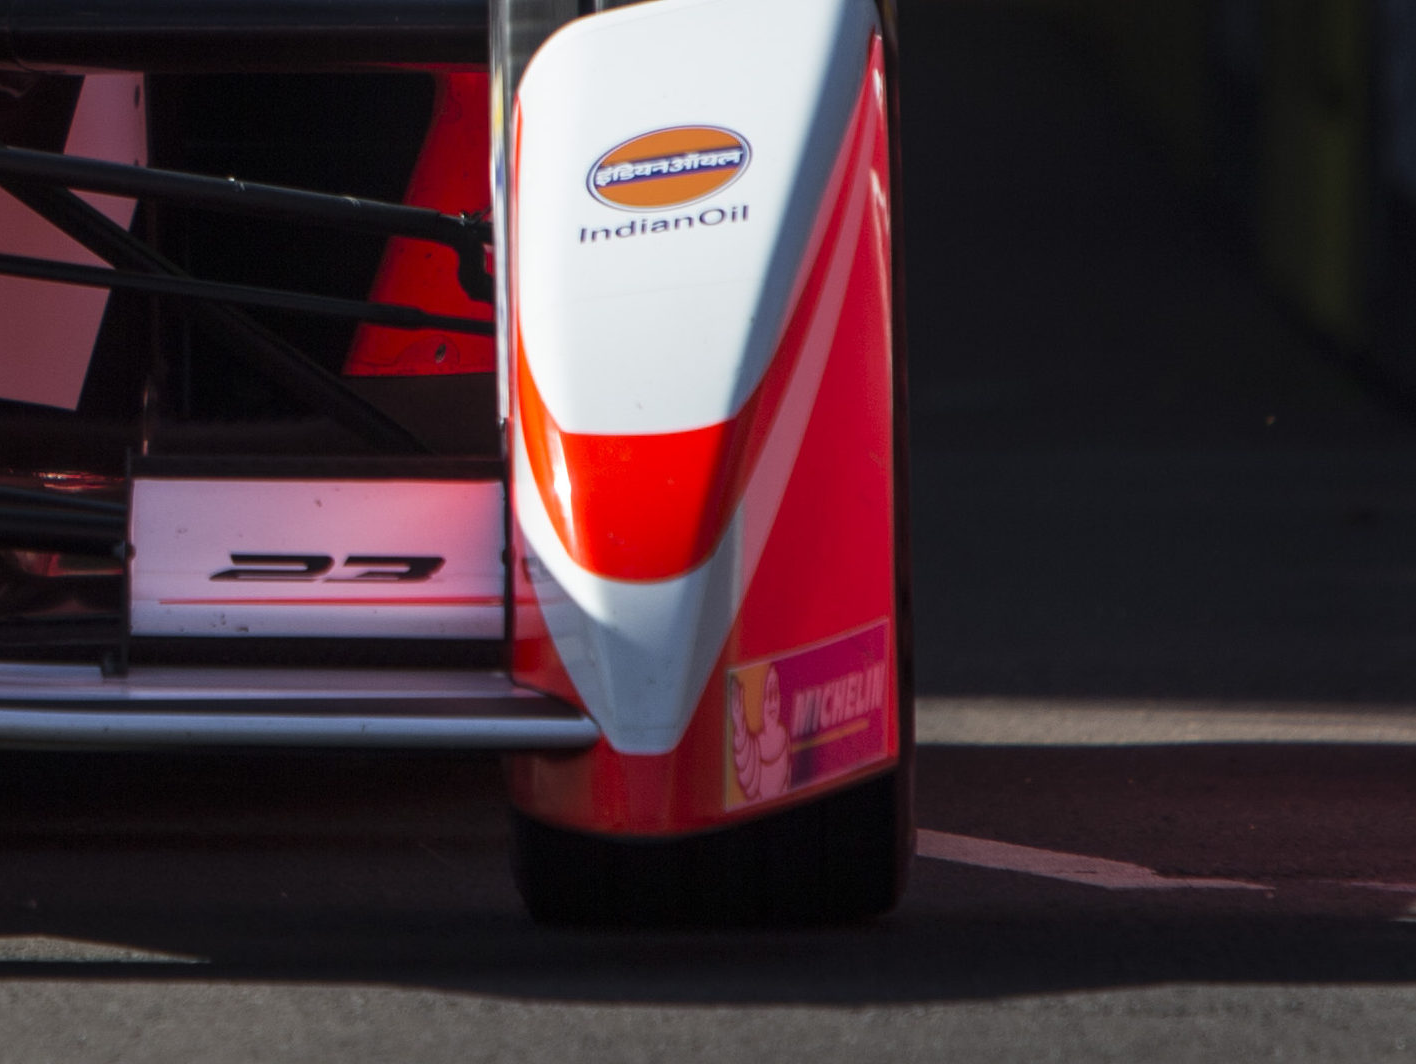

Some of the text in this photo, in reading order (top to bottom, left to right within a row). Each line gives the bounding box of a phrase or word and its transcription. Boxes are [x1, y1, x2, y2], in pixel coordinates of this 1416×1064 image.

[579, 204, 750, 244] IndianOil
[208, 552, 446, 583] 23
[791, 662, 885, 738] MICHELIN
